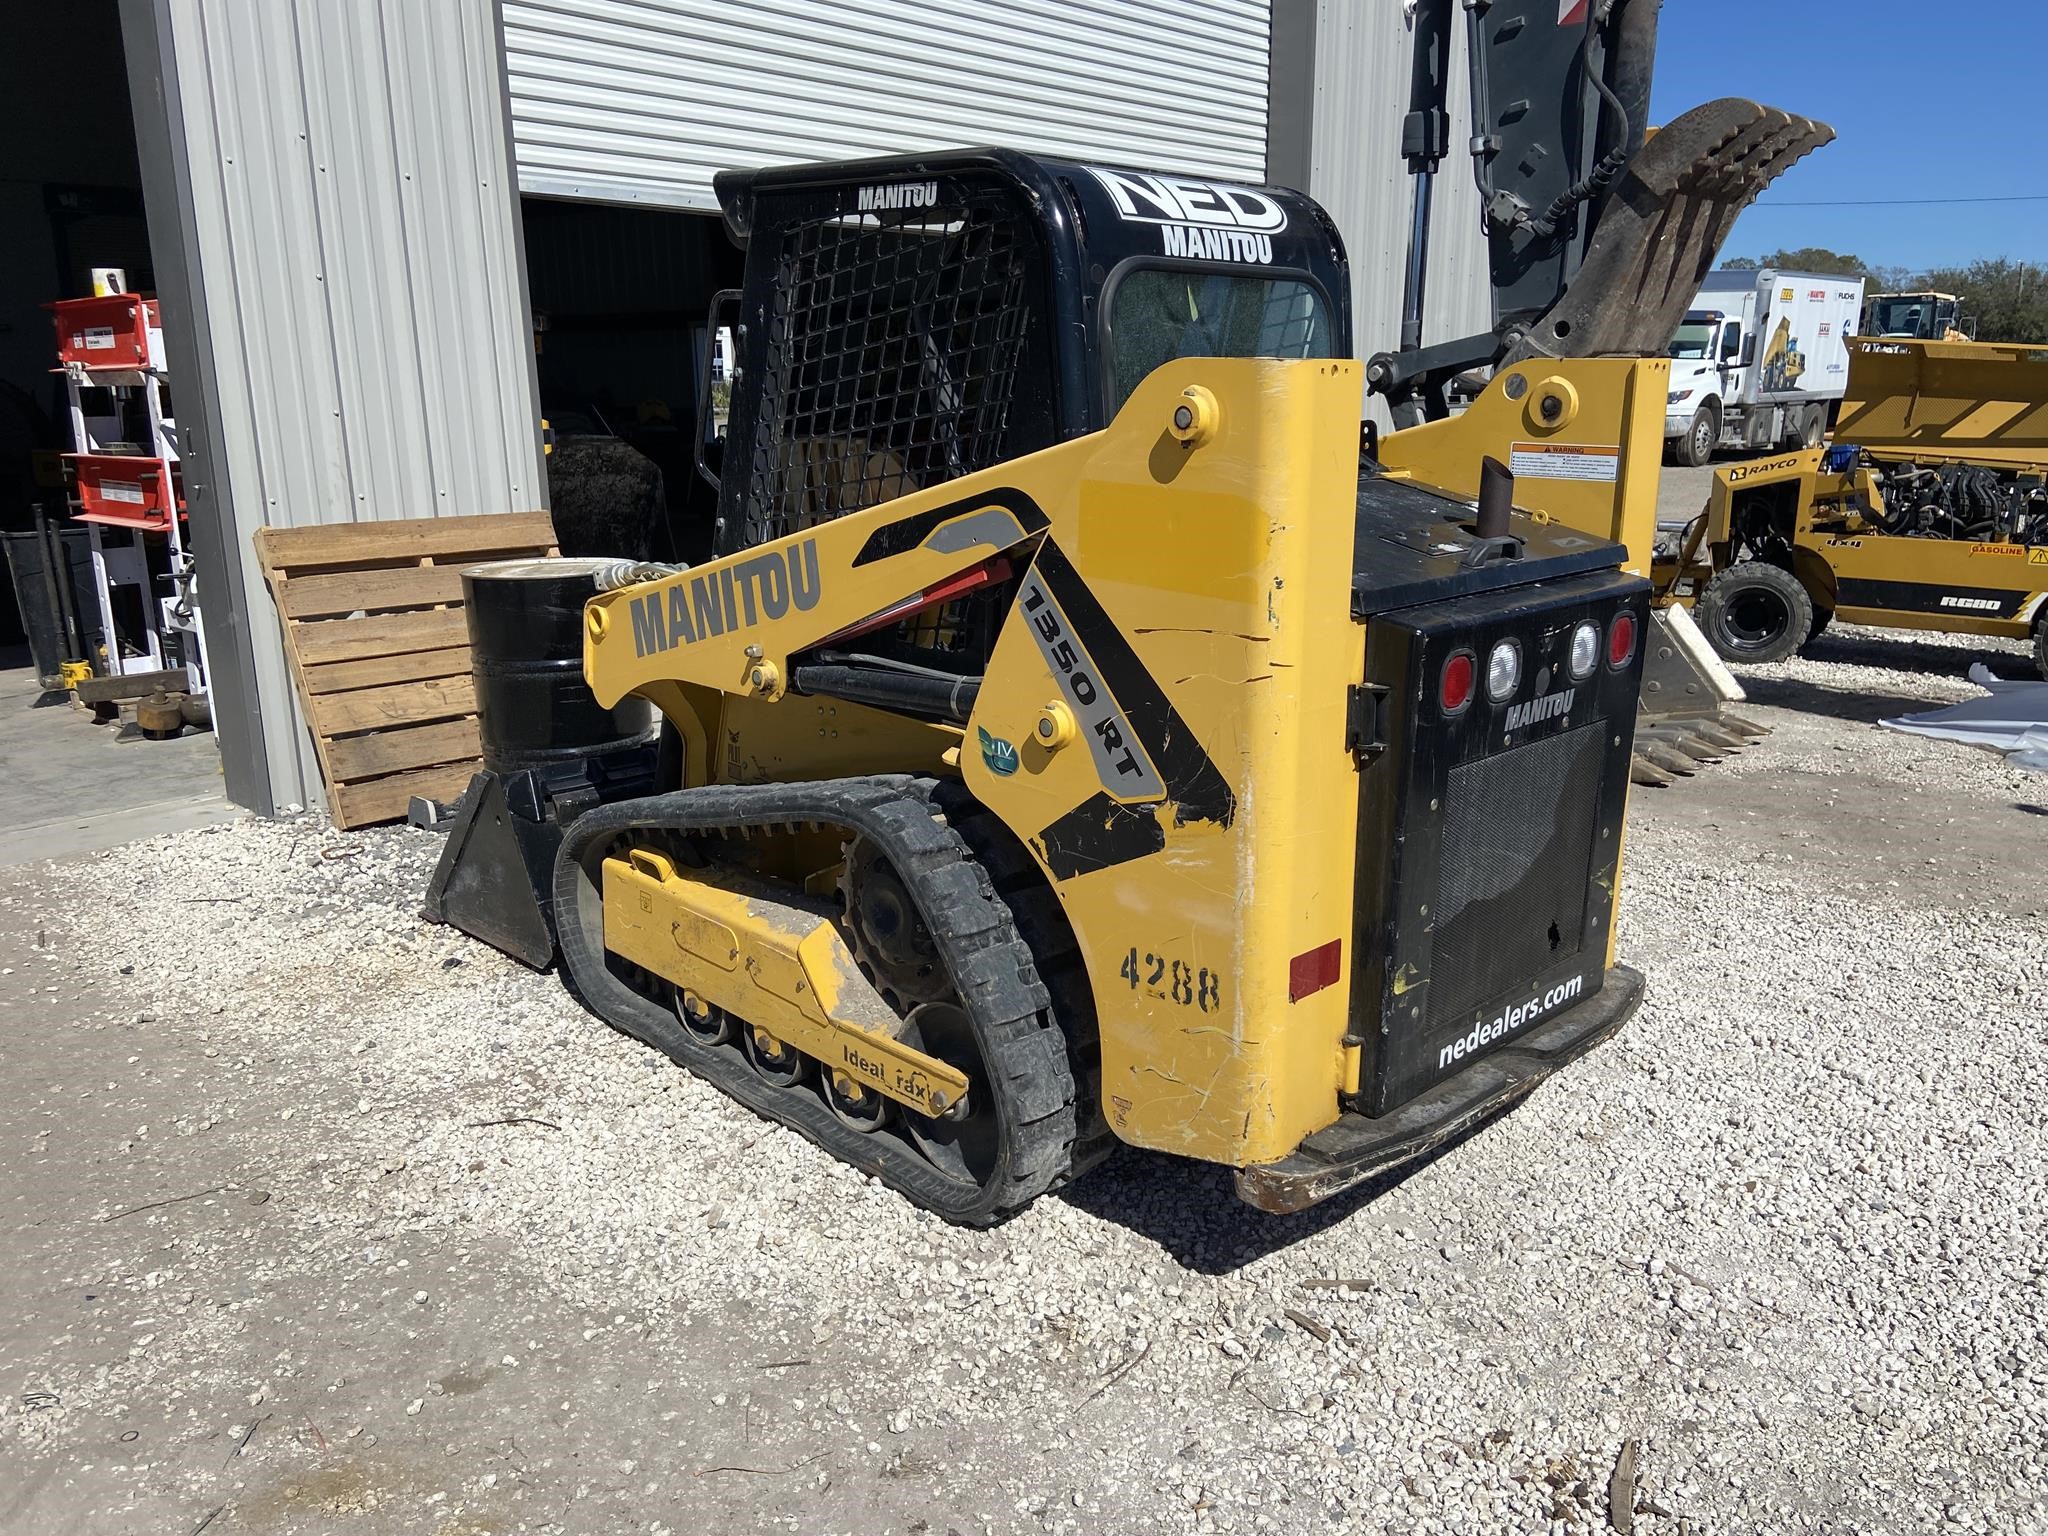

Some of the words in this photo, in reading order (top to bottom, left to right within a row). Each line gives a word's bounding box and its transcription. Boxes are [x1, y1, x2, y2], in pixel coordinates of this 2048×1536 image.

[858, 181, 938, 211] MANITOU
[1089, 167, 1284, 230] NED
[1161, 224, 1273, 265] MANITOU
[1838, 292, 1855, 300] FUCHS
[1551, 446, 1585, 455] WARNING
[1748, 458, 1797, 475] RAYCO
[1971, 545, 2024, 556] GASOLINE
[629, 537, 822, 660] MANITOU
[1024, 584, 1097, 706] 1350
[1093, 716, 1144, 778] RT
[1503, 687, 1576, 732] MANITOU
[997, 741, 1014, 757] IV
[1119, 946, 1220, 1015] 4288
[1438, 974, 1583, 1070] nedealers.com
